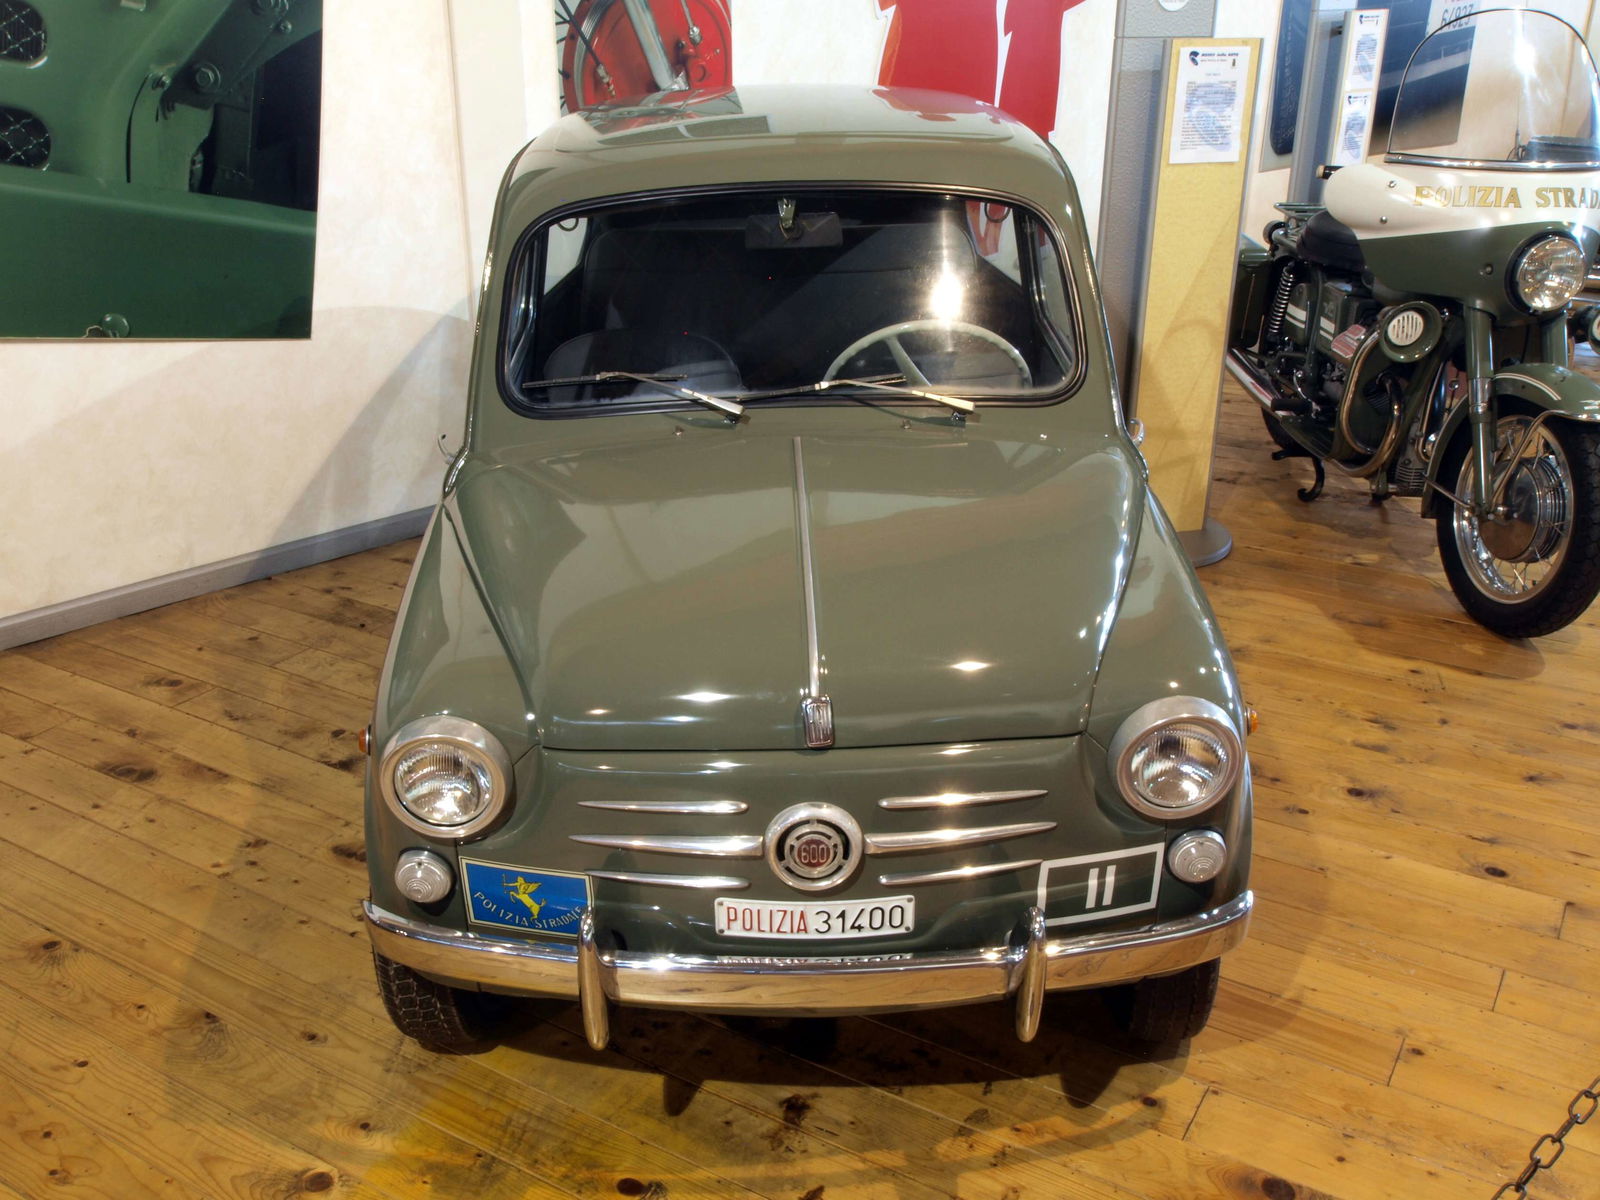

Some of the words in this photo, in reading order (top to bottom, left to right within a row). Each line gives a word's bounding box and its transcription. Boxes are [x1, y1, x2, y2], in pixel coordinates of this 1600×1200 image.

[1414, 186, 1521, 208] POLIZIA
[1535, 187, 1600, 209] STRAD
[801, 844, 827, 864] 600
[473, 891, 529, 927] POLIZIA
[726, 906, 808, 934] POLIZIA
[814, 904, 905, 934] 31400
